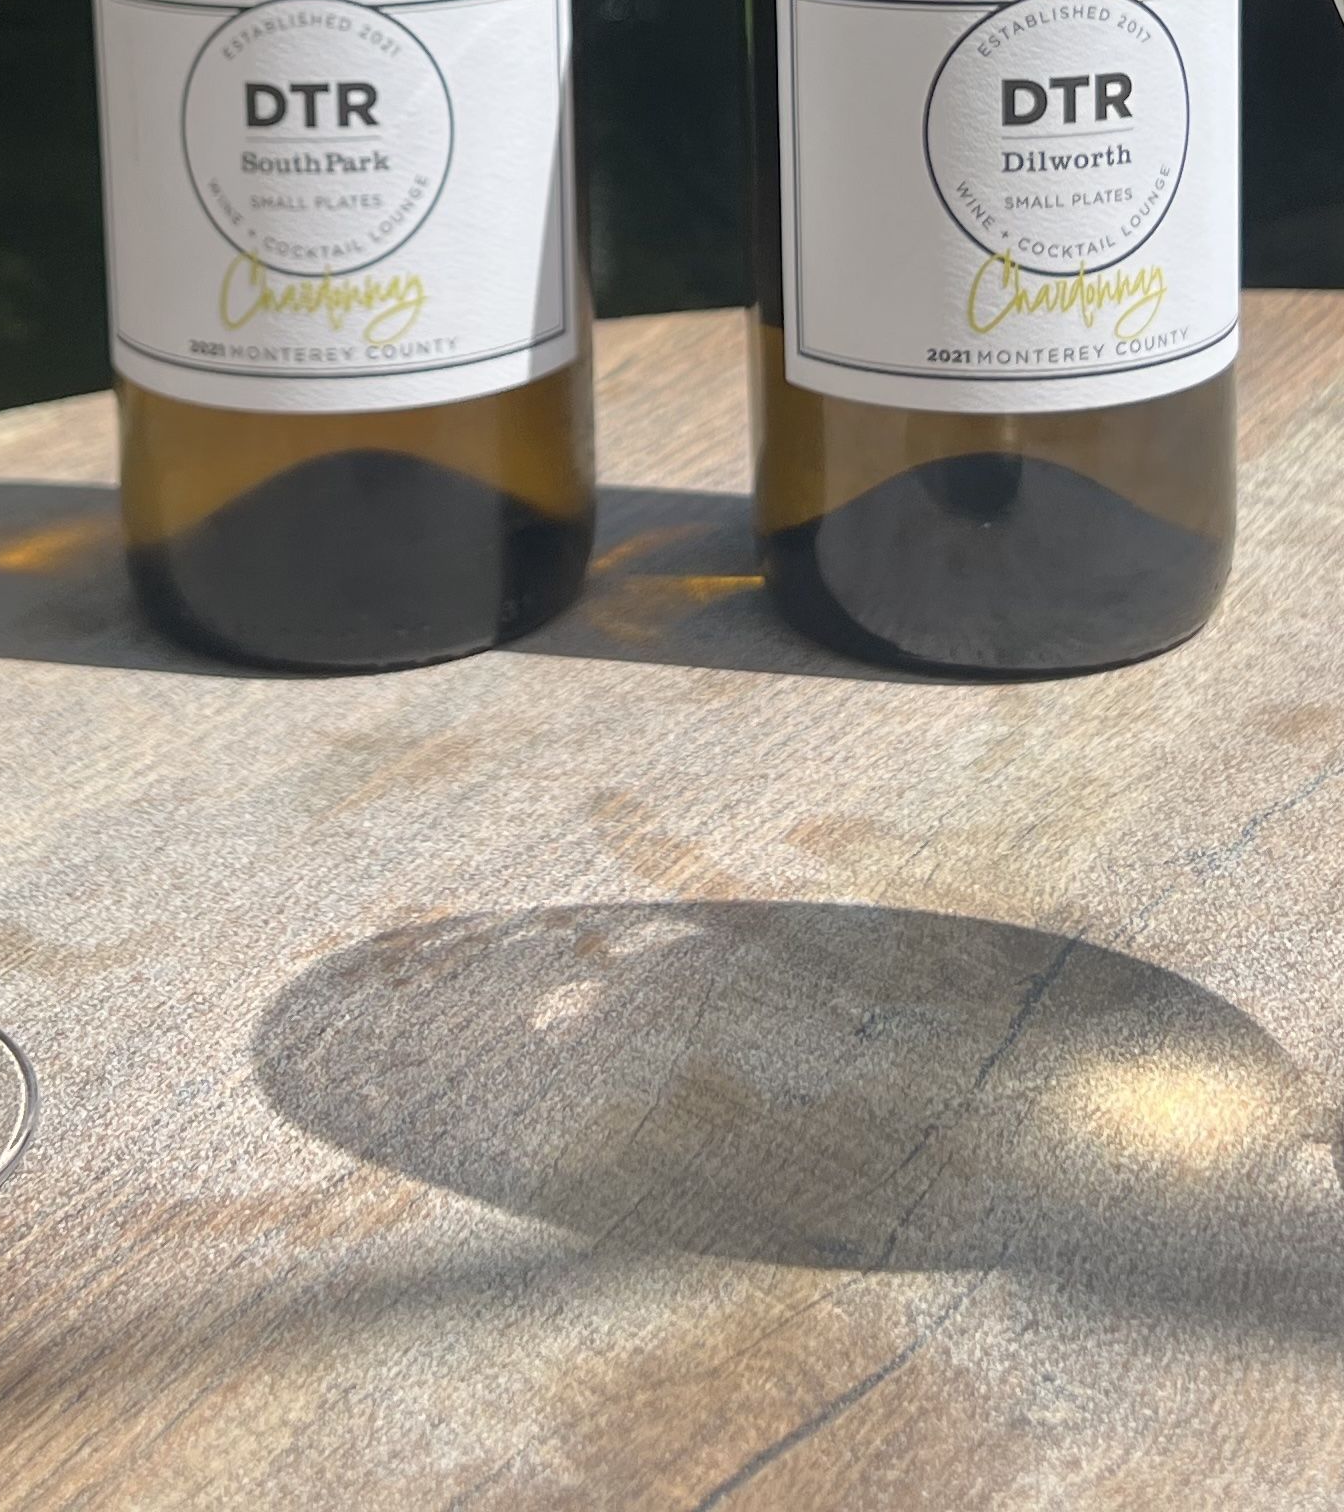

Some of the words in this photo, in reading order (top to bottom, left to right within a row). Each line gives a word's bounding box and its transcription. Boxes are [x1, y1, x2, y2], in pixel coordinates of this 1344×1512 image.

[222, 11, 353, 61] ESTABLISHED
[358, 23, 403, 57] 2021
[977, 5, 1111, 58] ESTABLISHED
[1117, 15, 1152, 45] 2017
[244, 82, 379, 128] DTR
[1001, 72, 1133, 127] DTR
[1001, 144, 1132, 173] Dilworth
[209, 178, 244, 226] WINE
[262, 236, 364, 259] COCKTAIL
[368, 175, 429, 244] LOUNGE
[249, 194, 306, 210] SMALL
[315, 193, 383, 209] PLATES
[957, 180, 996, 231] WINE
[1017, 236, 1116, 259] COCKTAIL
[1120, 165, 1172, 237] LOUNGE
[1004, 196, 1065, 210] SMALL
[1072, 187, 1133, 206] PLATES
[219, 250, 429, 345] Chardonnay
[967, 248, 1168, 340] Chardonnay
[226, 345, 354, 363] MONTEREY
[365, 336, 458, 361] COUNTY
[927, 348, 971, 364] 2021
[977, 344, 1105, 365] MONTEREY
[1115, 327, 1190, 356] COUNTY
